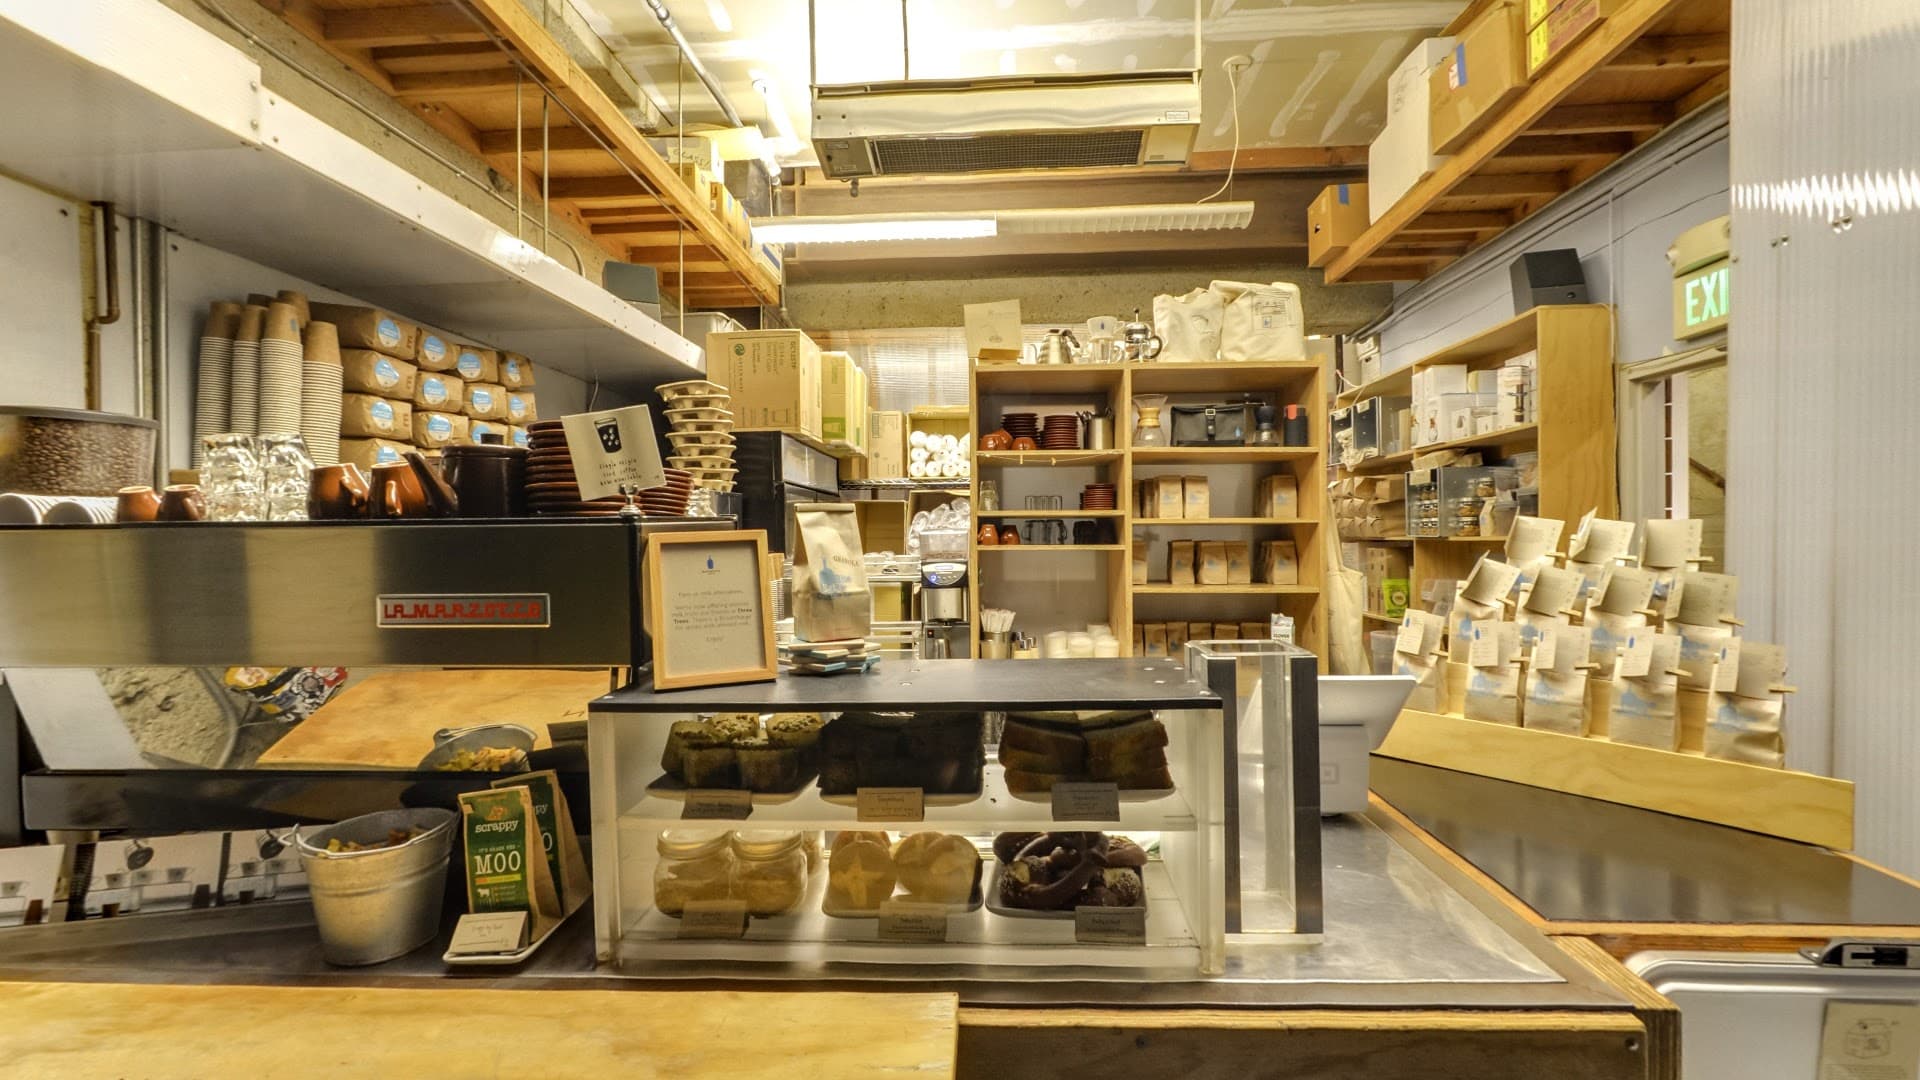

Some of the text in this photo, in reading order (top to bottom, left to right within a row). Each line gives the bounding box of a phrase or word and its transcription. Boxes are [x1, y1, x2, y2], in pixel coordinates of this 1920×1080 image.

[1685, 267, 1729, 326] EXI
[475, 820, 519, 833] scrappy
[474, 850, 521, 875] MOO
